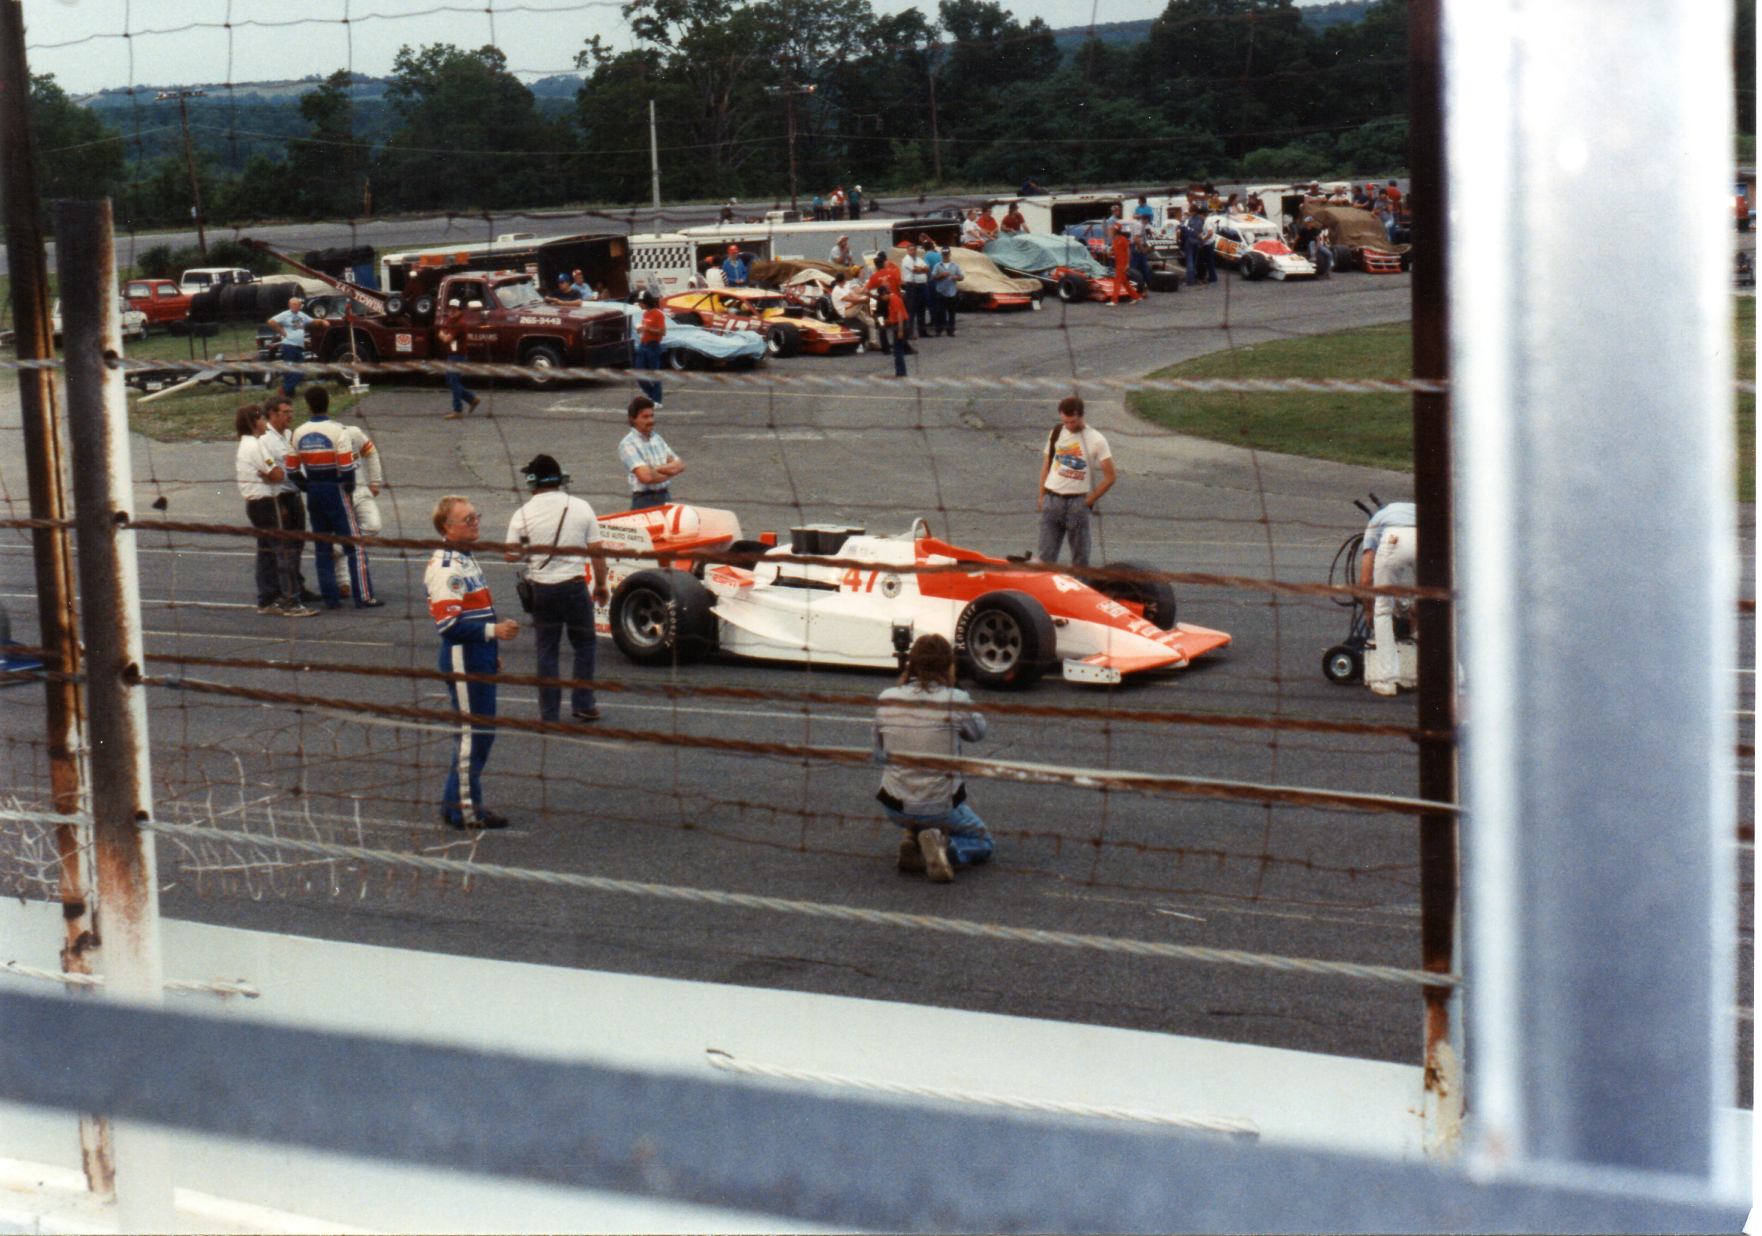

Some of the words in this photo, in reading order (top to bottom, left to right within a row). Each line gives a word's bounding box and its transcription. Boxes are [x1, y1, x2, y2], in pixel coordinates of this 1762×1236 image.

[611, 532, 626, 540] AUTO
[627, 534, 645, 543] PARTS
[842, 563, 881, 593] 47
